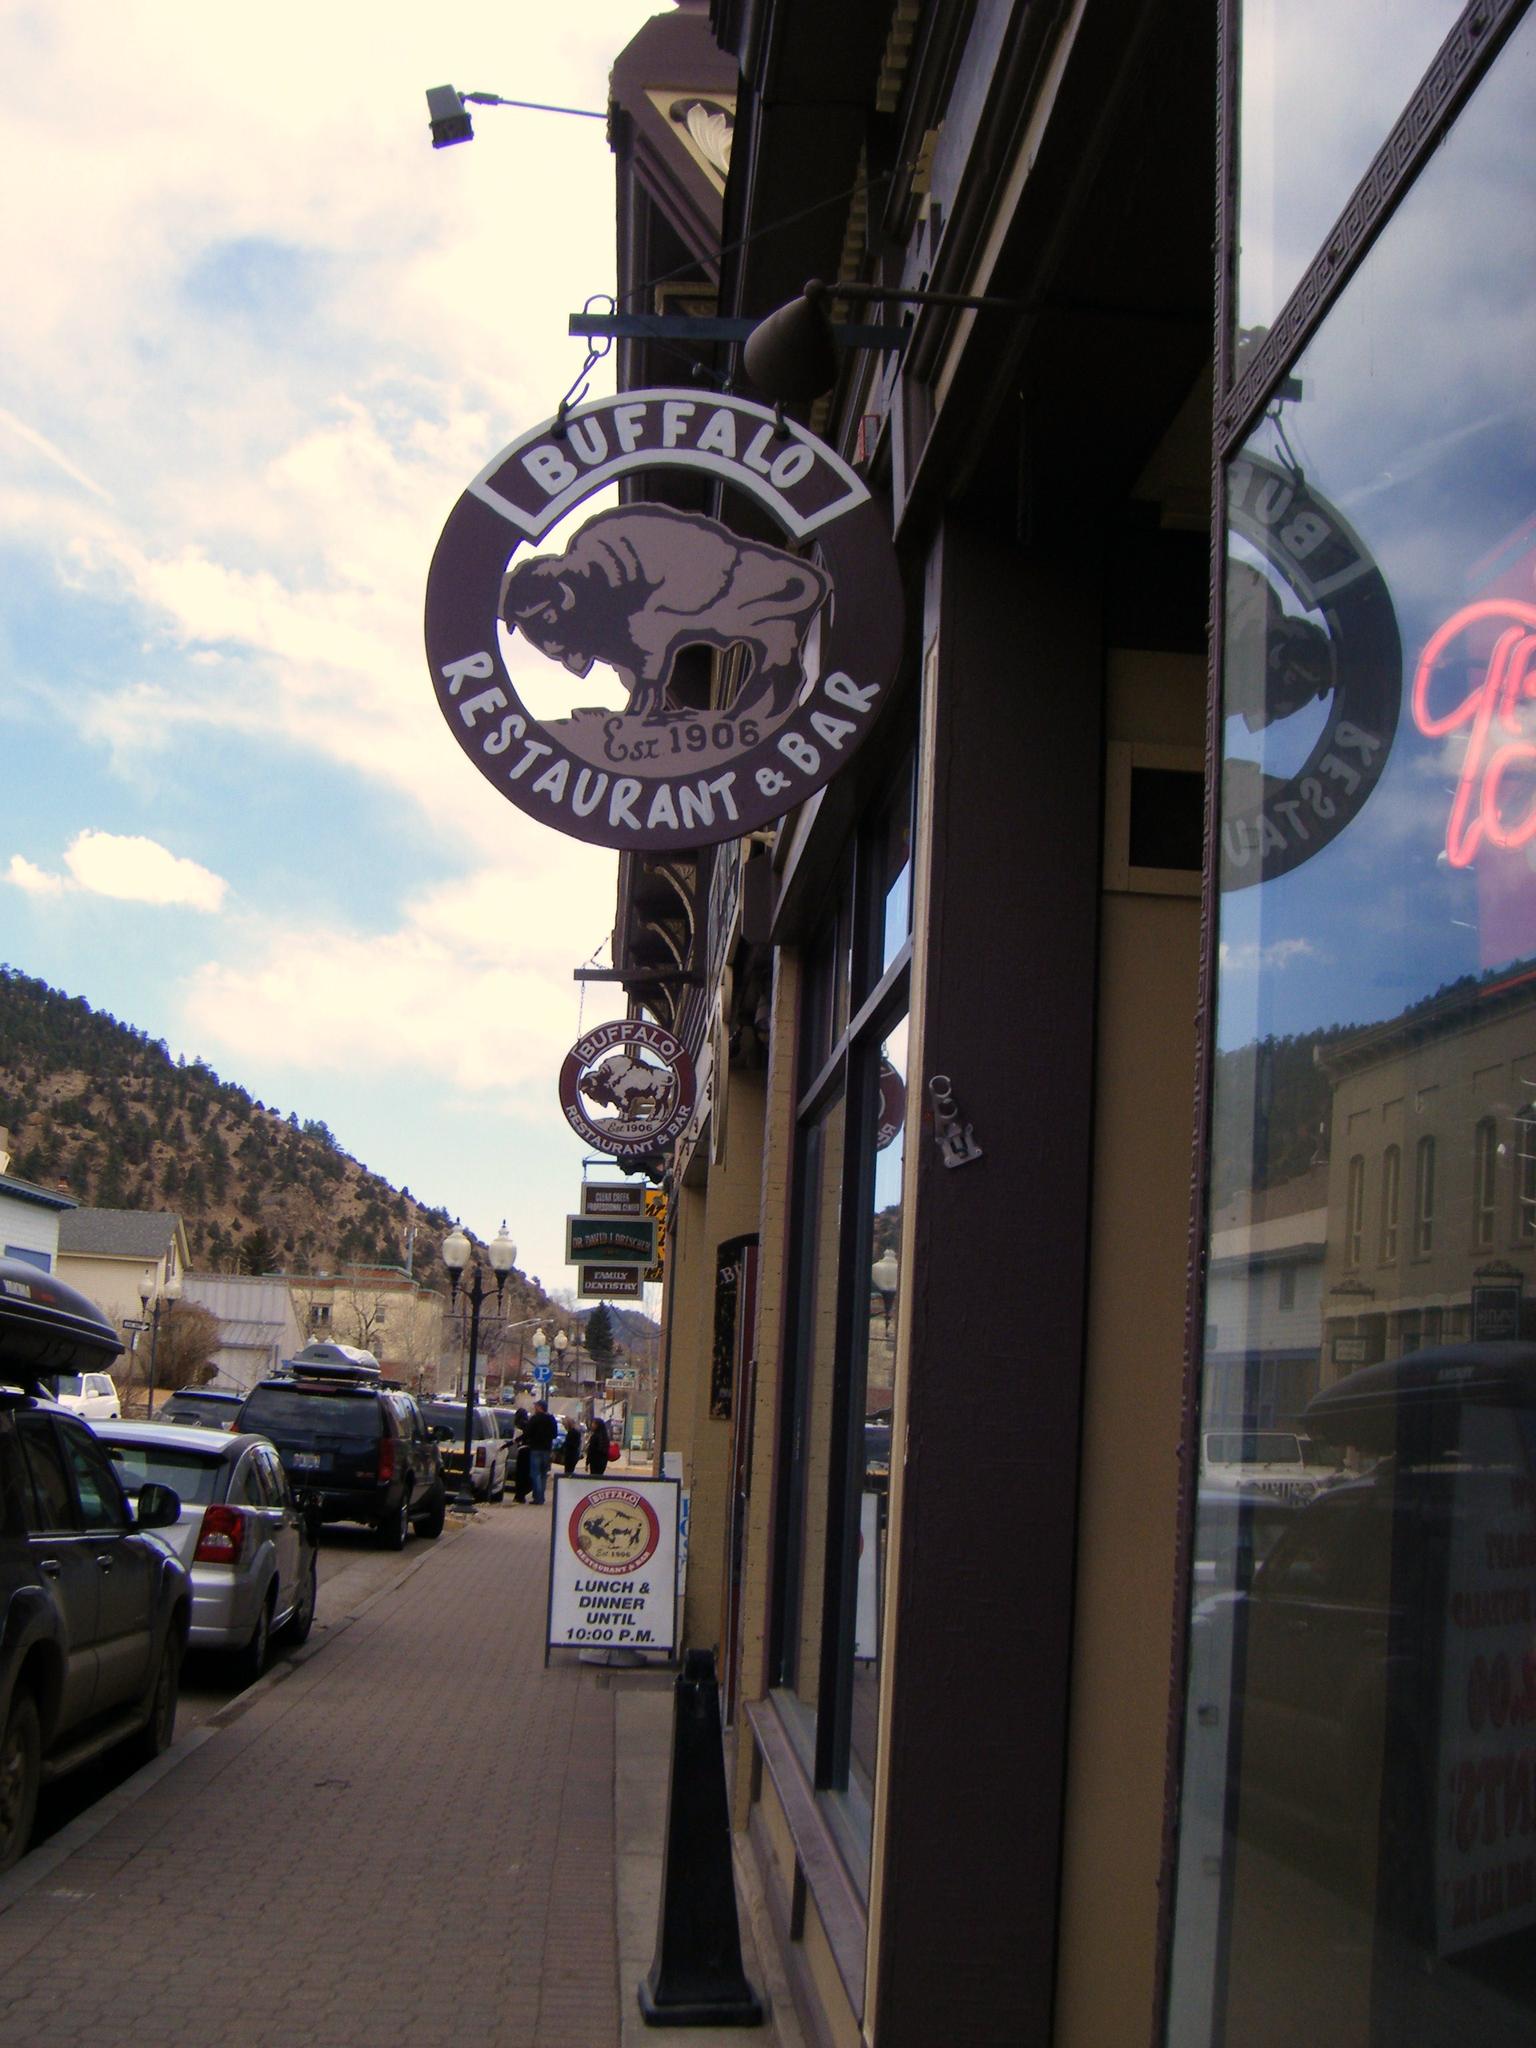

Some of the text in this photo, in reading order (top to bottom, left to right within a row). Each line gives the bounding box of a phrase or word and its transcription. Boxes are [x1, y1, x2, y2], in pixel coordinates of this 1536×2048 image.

[521, 401, 815, 496] BUFFALO
[442, 650, 881, 831] RESTAURANT & BAR
[671, 719, 760, 754] 1906
[580, 1025, 676, 1060] BUFFALO
[566, 1105, 691, 1154] RESTAURANT & BAR
[626, 1124, 653, 1132] 1906
[594, 1271, 629, 1280] FAMILY
[585, 1282, 638, 1291] DENTISTRY
[591, 1490, 636, 1504] BUFFALO
[577, 1549, 649, 1574] RESTAURANT & BAR
[574, 1580, 650, 1595] LUNCH &
[579, 1596, 645, 1610] DINNER
[586, 1612, 636, 1626] UNTIL
[567, 1628, 656, 1643] 10:00 P.M.
